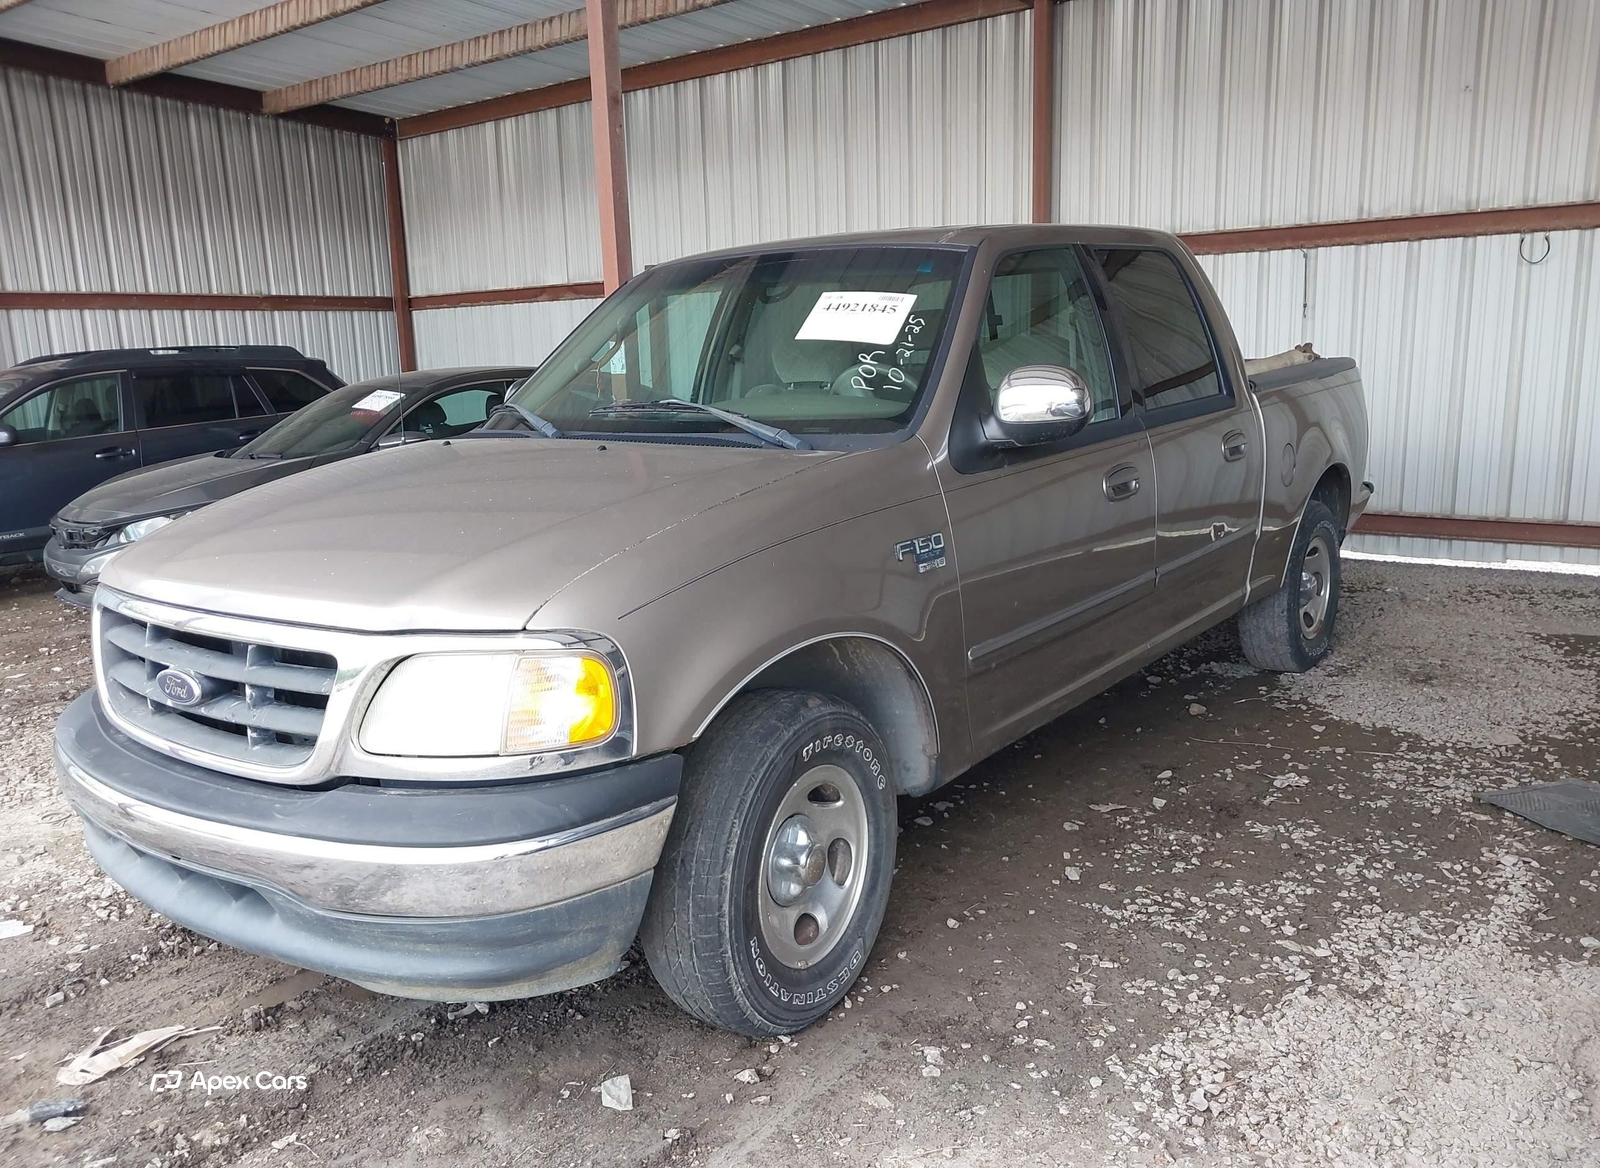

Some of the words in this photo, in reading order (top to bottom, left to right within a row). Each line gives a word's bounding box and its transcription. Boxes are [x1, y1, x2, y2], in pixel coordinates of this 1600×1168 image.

[822, 302, 899, 314] 44921845
[850, 350, 886, 390] POR
[882, 314, 926, 390] 10-21-25
[164, 675, 188, 699] Ford
[802, 733, 886, 790] Firestone
[750, 936, 862, 1005] DESTINATION
